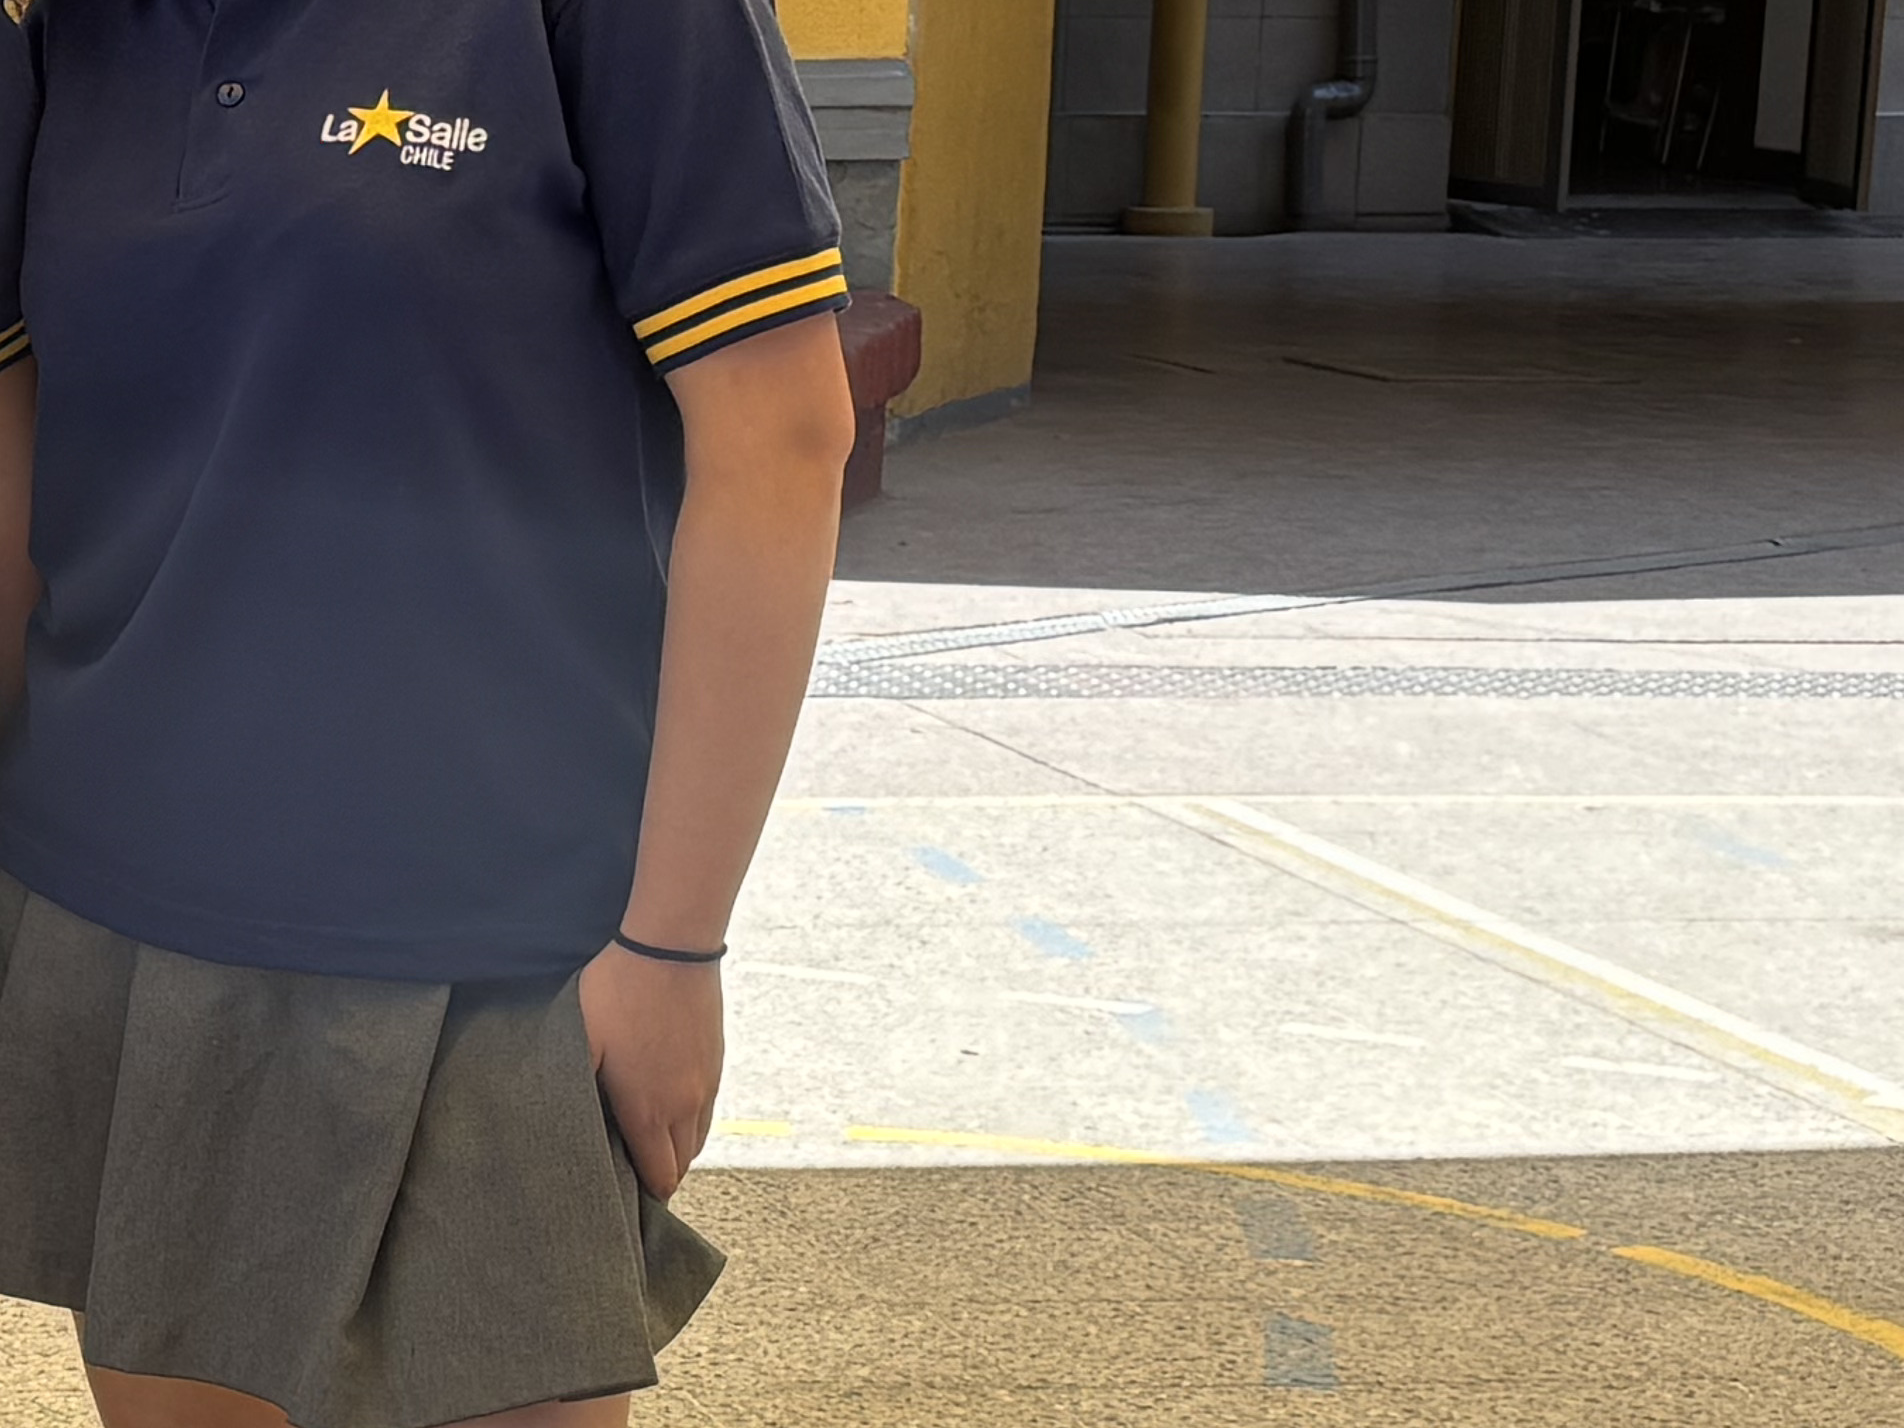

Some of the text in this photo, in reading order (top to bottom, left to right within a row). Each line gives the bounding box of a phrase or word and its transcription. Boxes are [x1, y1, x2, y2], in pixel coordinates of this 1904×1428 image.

[321, 113, 488, 152] La Salle
[400, 144, 454, 170] CHILE
